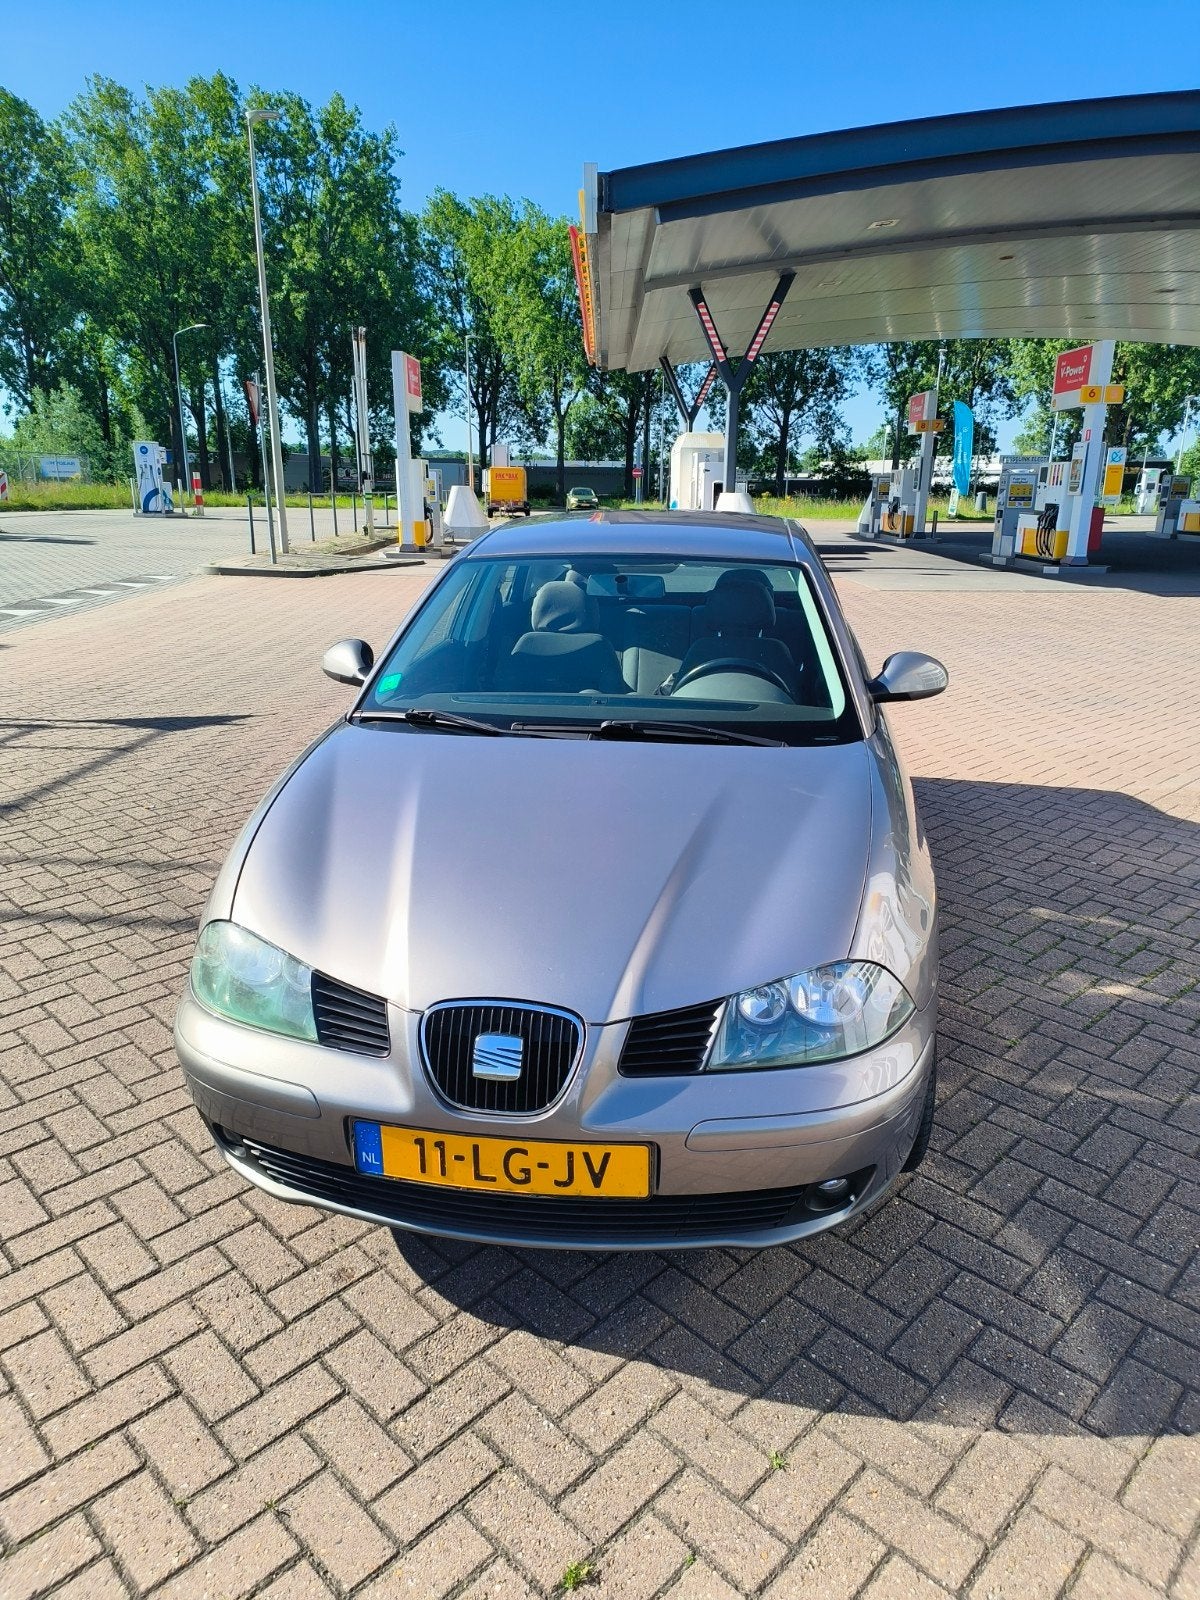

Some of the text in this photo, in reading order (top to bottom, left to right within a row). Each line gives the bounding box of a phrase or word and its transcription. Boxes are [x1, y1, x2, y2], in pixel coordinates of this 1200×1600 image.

[1061, 366, 1085, 378] V-Power
[1088, 388, 1096, 398] 6
[362, 1151, 380, 1166] NL
[414, 1137, 612, 1189] 11-LG-JV
